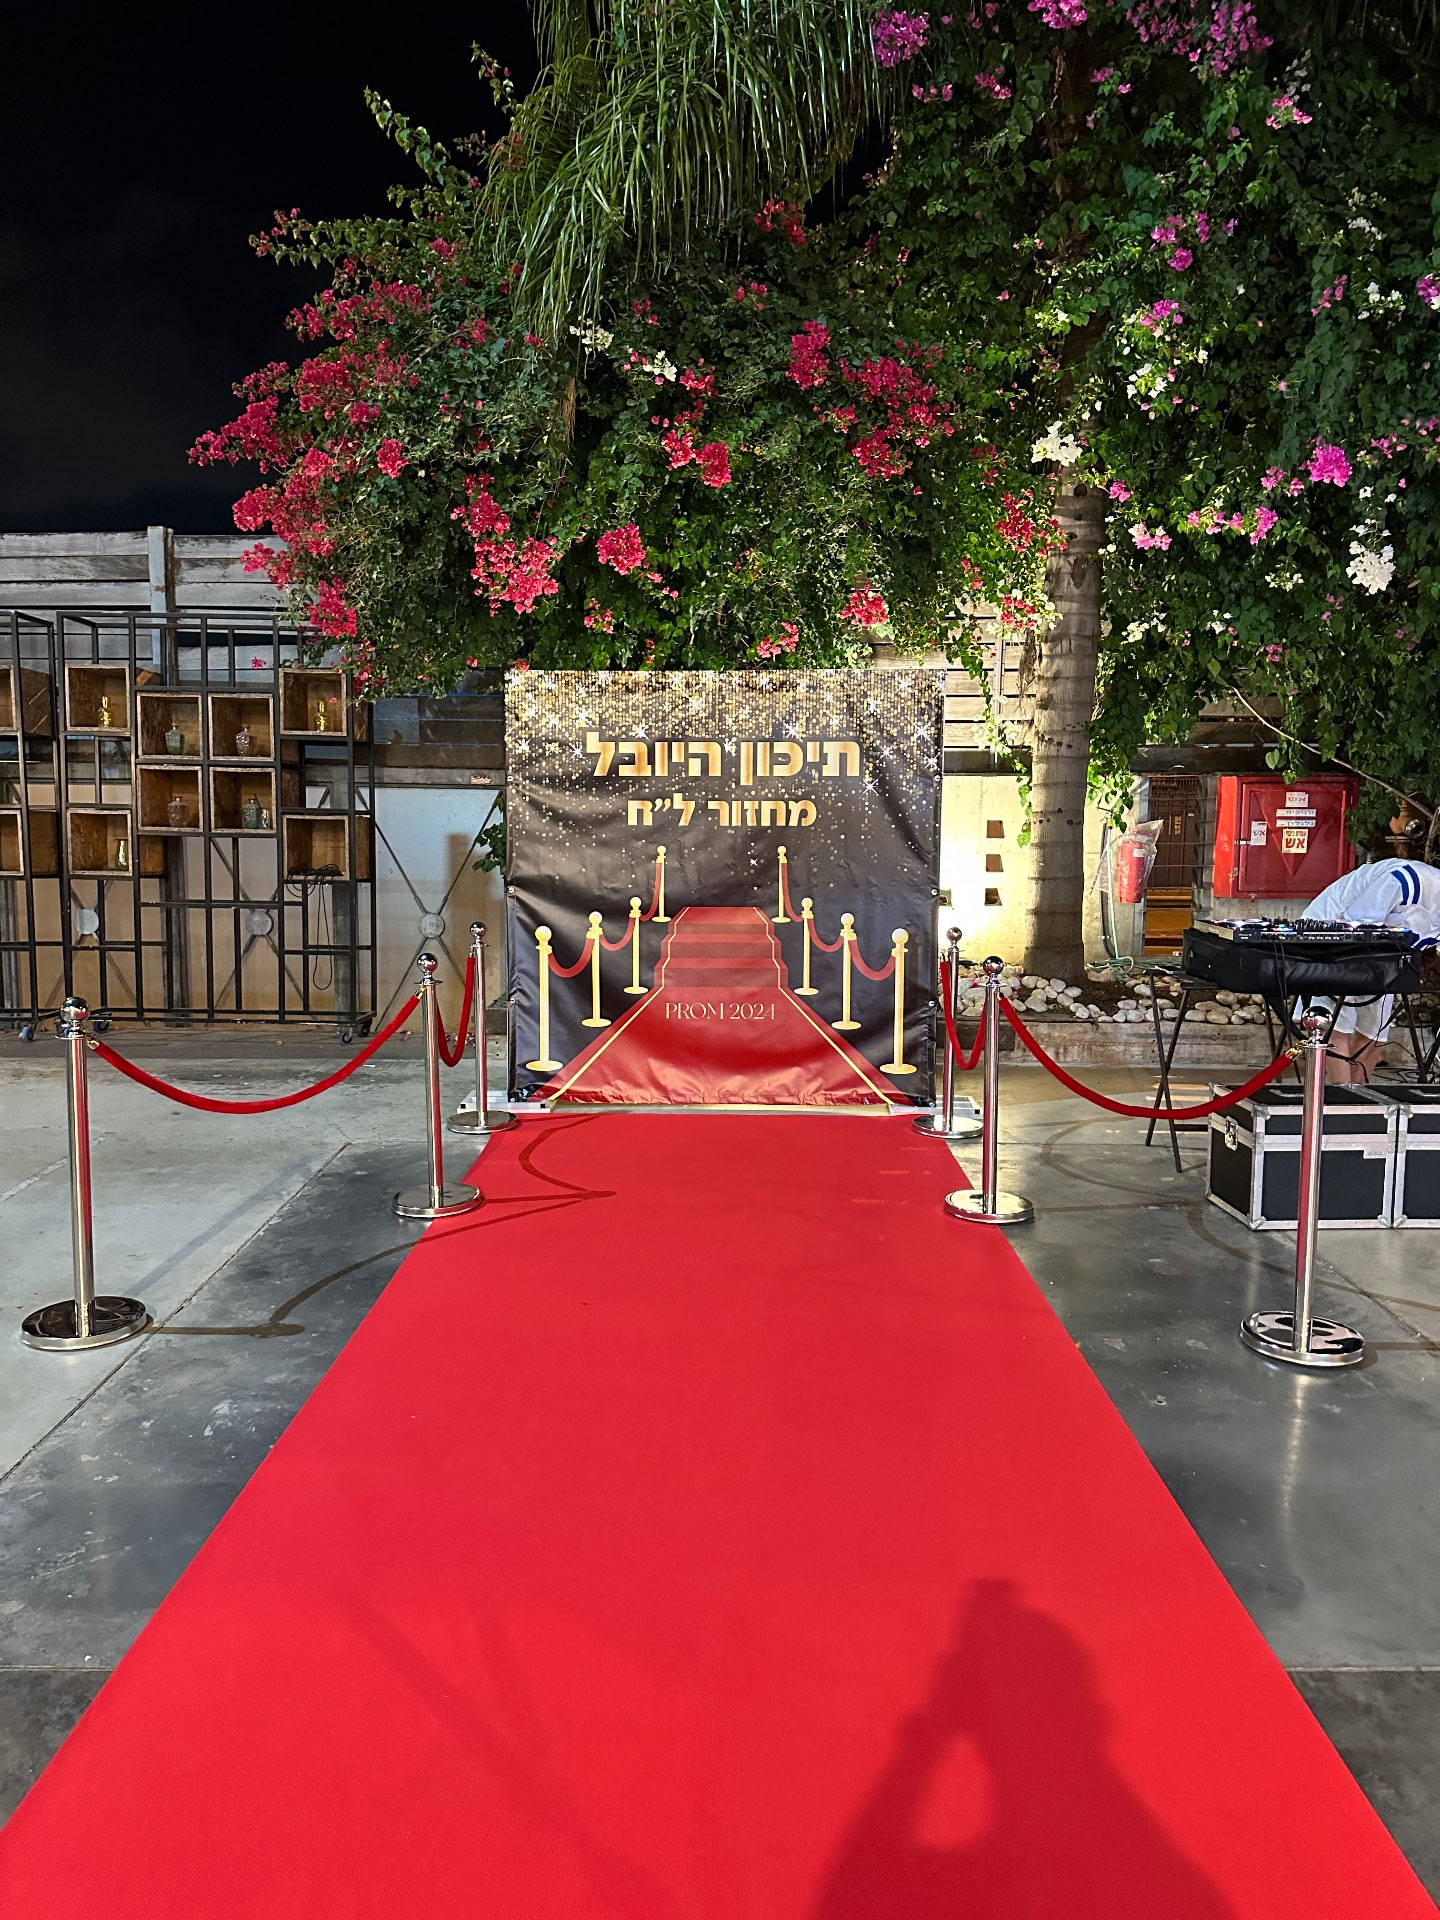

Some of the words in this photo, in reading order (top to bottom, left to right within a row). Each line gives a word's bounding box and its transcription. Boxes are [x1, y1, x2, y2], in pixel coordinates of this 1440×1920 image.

[586, 731, 722, 777] היובל
[740, 741, 860, 786] תיכון
[707, 799, 817, 827] מחזור
[1285, 837, 1306, 849] אש
[665, 1002, 724, 1020] PROM
[729, 1002, 775, 1020] 2024
